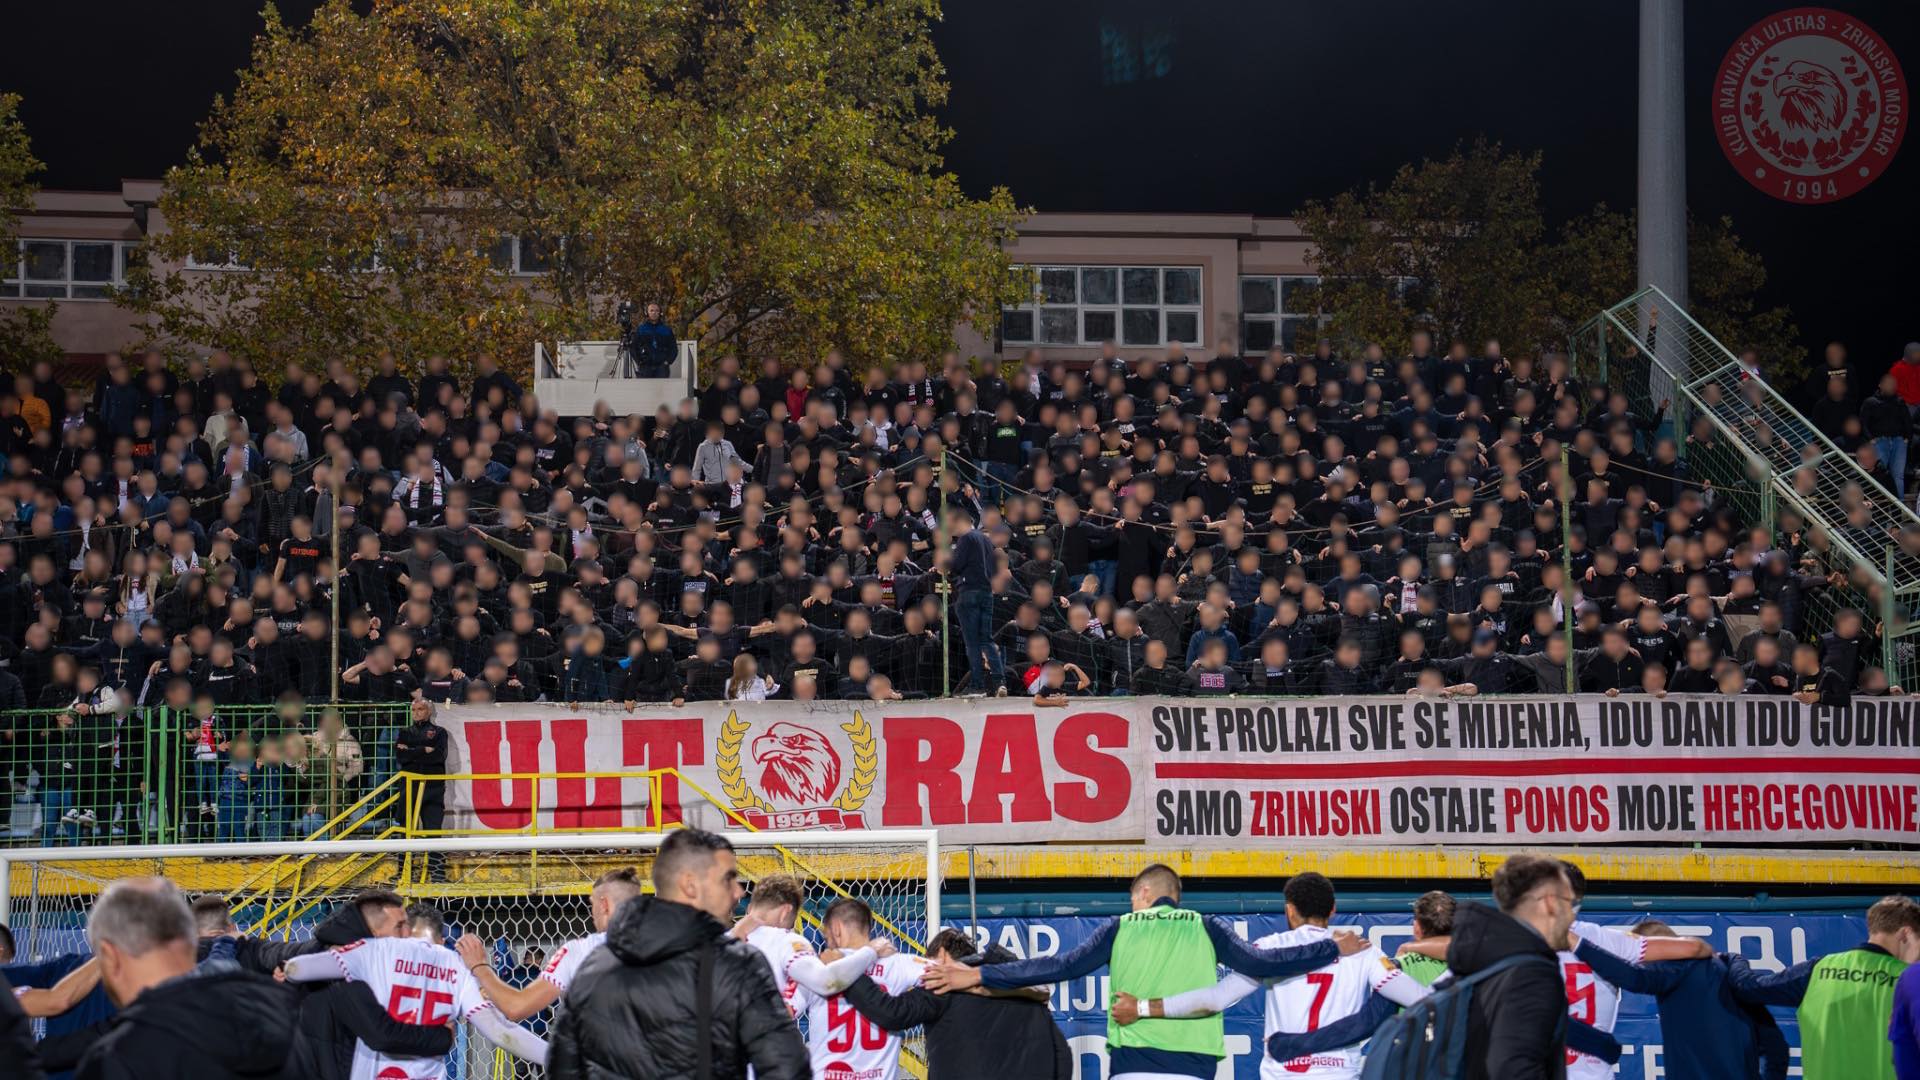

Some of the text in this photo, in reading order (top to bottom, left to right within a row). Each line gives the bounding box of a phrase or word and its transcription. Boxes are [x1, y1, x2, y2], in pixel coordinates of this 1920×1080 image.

[1152, 706, 1209, 752] SVE
[1215, 706, 1342, 752] PROLAZI
[1350, 704, 1406, 750] SVE
[1413, 702, 1451, 750] SE
[1458, 701, 1590, 752] MIJENJA,
[1600, 701, 1654, 748] IDU
[1662, 700, 1736, 747] DANI
[1746, 700, 1801, 747] IDU
[882, 712, 1132, 826] RAS
[768, 811, 820, 829] 1994
[1157, 789, 1242, 836] SAMO
[1250, 788, 1382, 837] ZRINJSKI
[1390, 787, 1497, 834] OSTAJE
[1504, 785, 1611, 834] PONOS
[1617, 784, 1696, 833] MOJE
[1307, 973, 1334, 1031] 7
